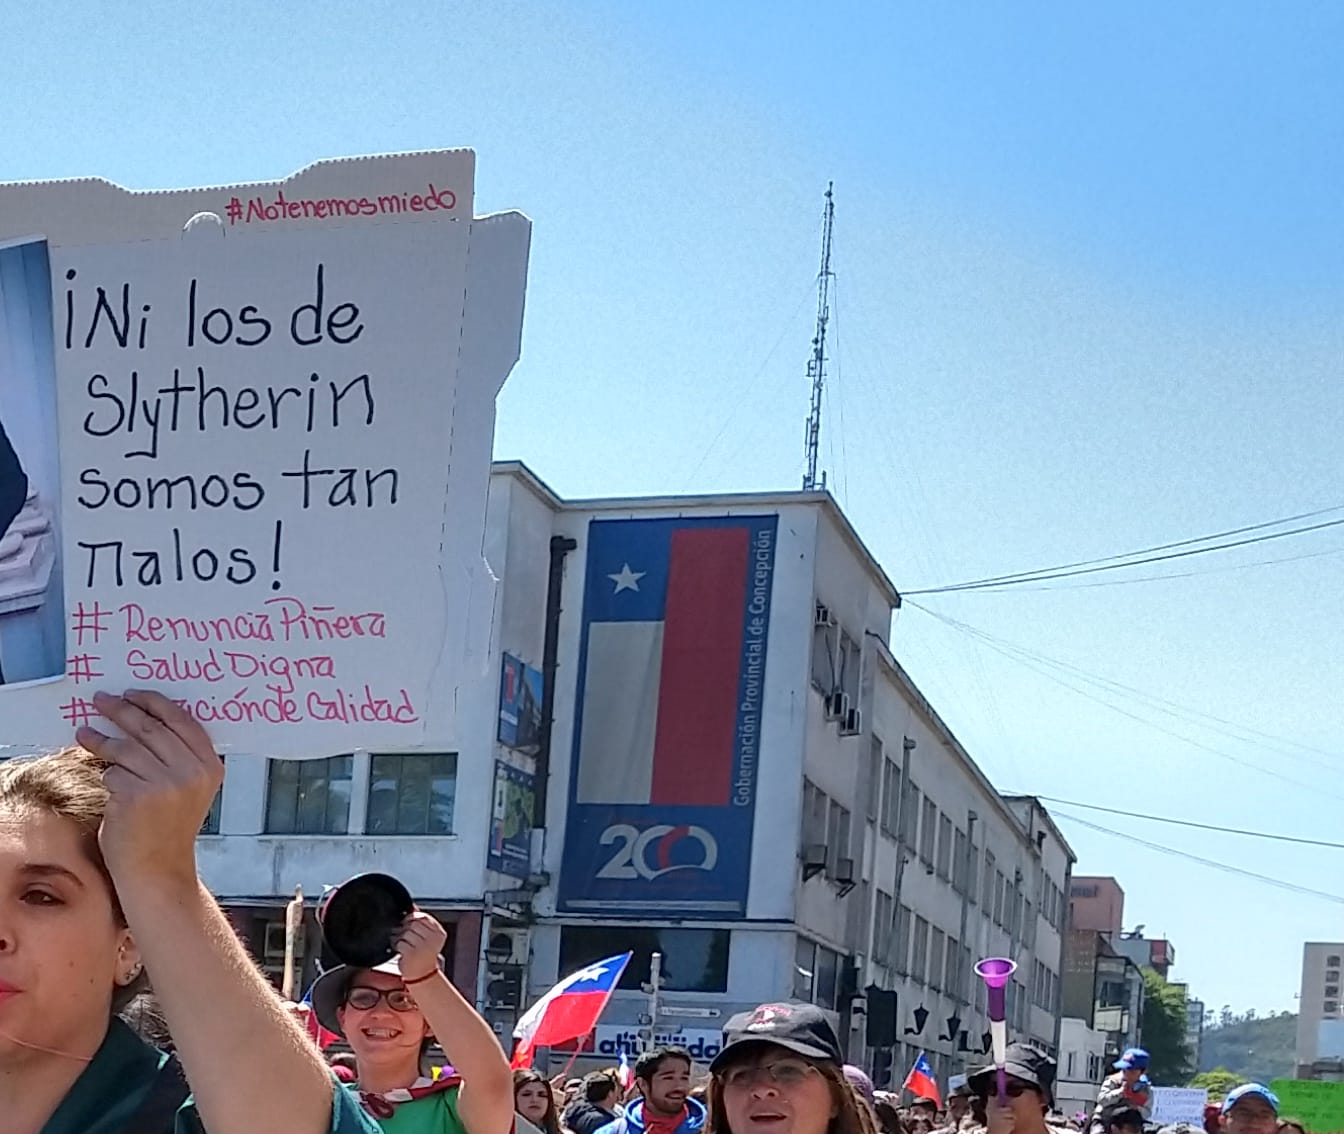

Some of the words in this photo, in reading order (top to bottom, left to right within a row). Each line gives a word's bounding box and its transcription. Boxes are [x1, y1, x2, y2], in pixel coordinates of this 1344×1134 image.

[187, 279, 272, 347] los
[290, 263, 364, 346] de
[83, 366, 375, 459] Slytherin
[76, 468, 265, 511] somos
[281, 449, 399, 510] tan
[748, 529, 773, 615] Concepción
[747, 617, 763, 635] de
[741, 639, 762, 712] Provincial
[733, 715, 756, 807] Gobernación
[594, 823, 718, 882] 200
[598, 1031, 723, 1060] ahuda
